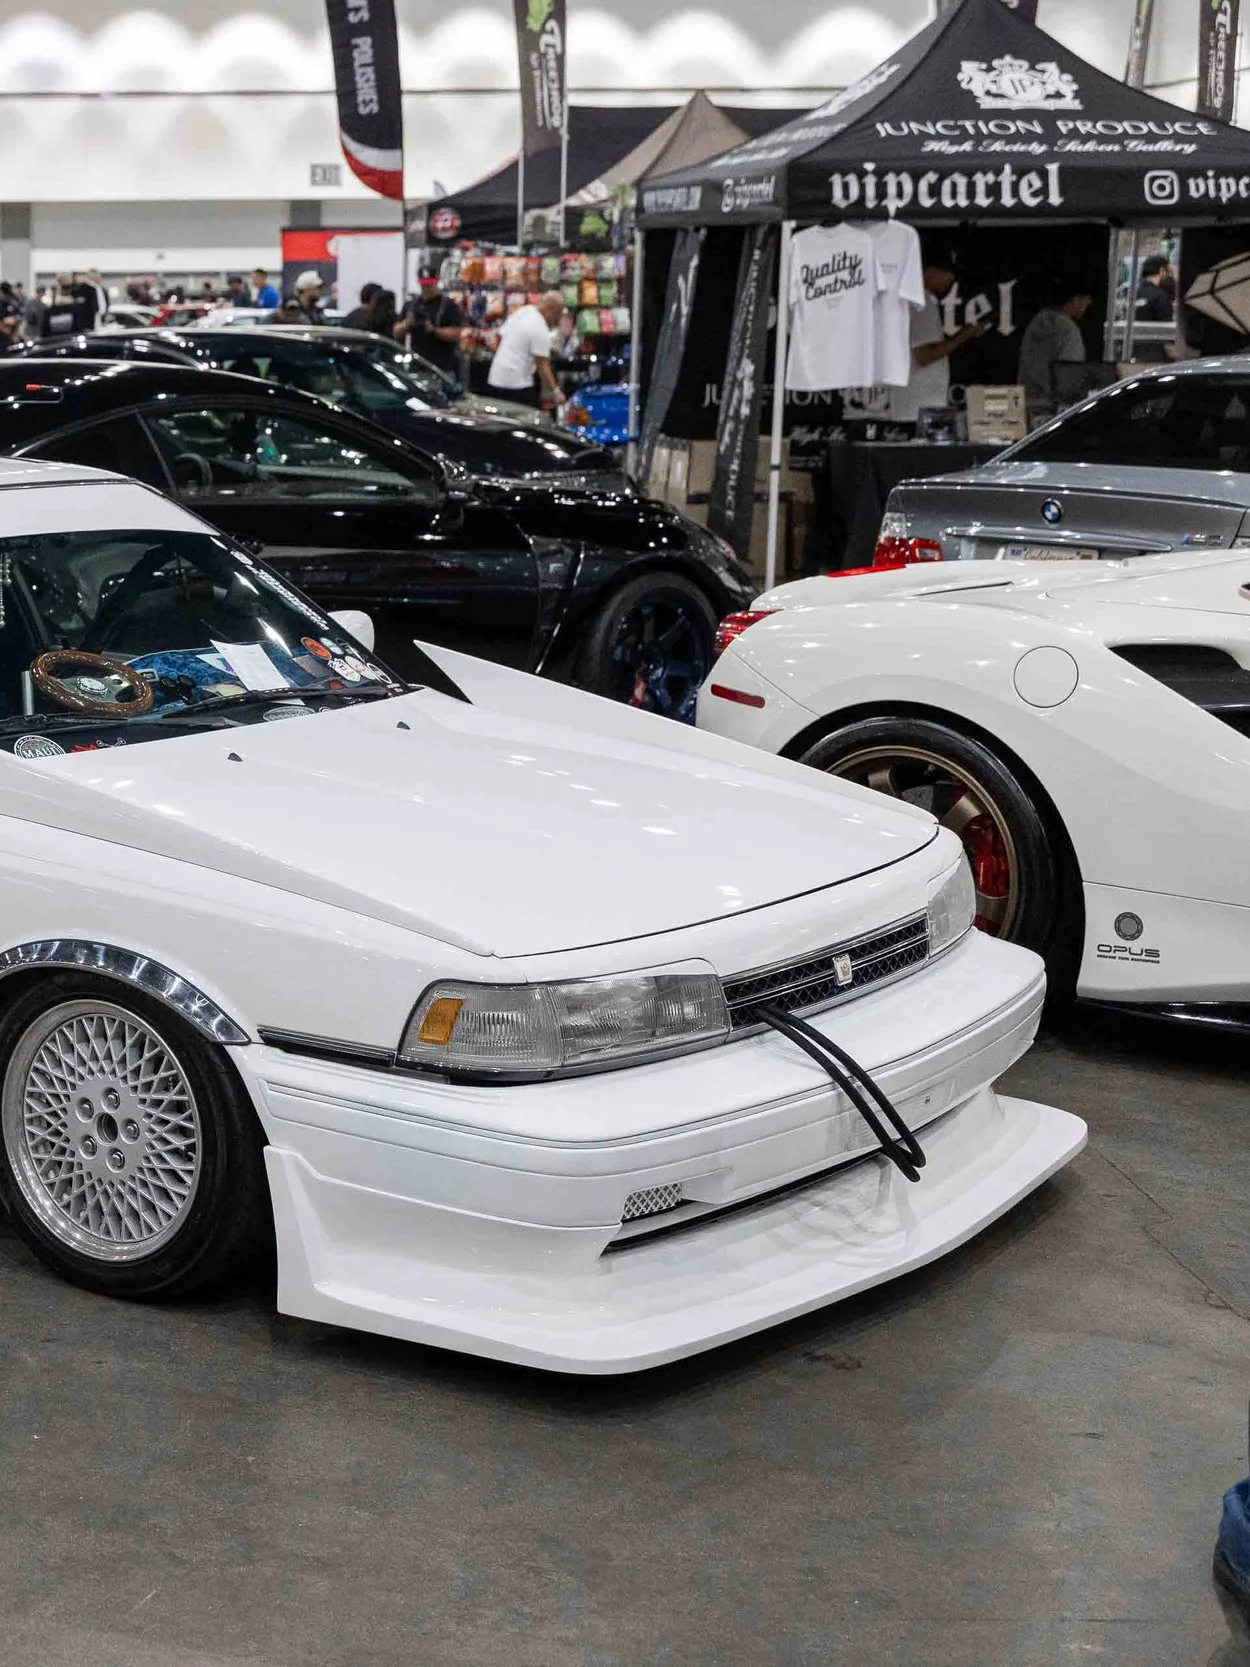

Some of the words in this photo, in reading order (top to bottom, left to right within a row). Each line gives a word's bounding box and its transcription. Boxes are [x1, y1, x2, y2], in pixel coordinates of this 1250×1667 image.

[351, 36, 379, 116] POLISHES
[875, 119, 1044, 138] JUNCTION
[1056, 119, 1218, 136] PRODUCE
[311, 165, 341, 186] EXIT
[828, 161, 1066, 219] vipcartel
[800, 250, 863, 284] Quality
[804, 267, 866, 301] Control
[1097, 944, 1160, 958] OPUS
